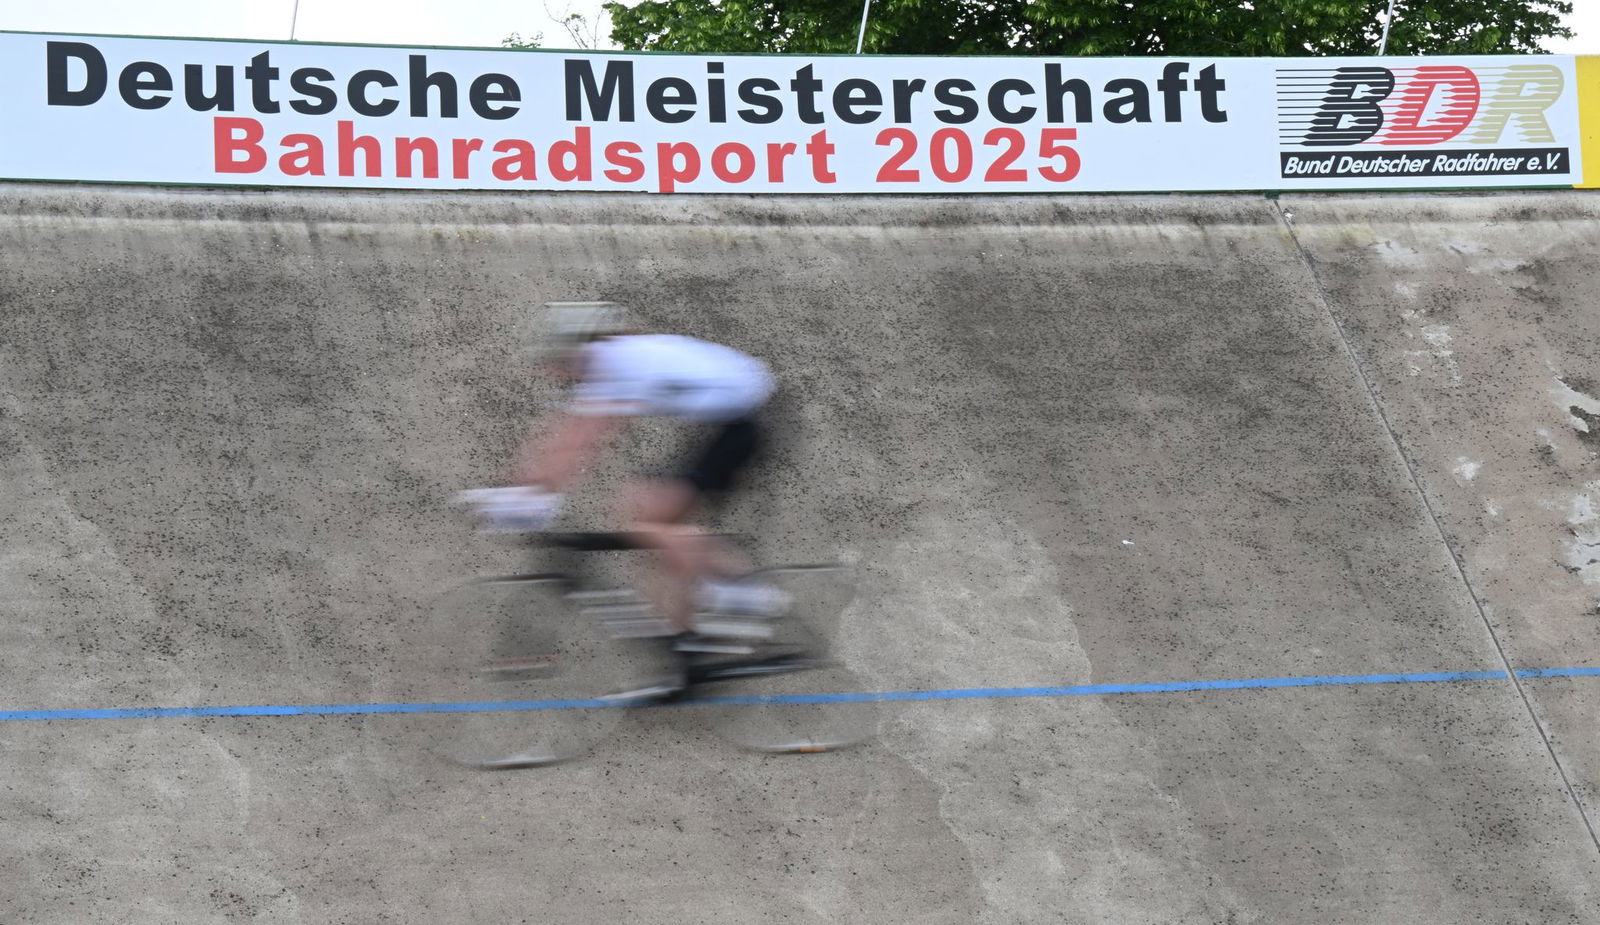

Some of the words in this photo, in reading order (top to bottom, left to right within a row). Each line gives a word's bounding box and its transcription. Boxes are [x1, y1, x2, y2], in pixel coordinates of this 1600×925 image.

[47, 41, 521, 120] Deutsche
[564, 59, 1228, 124] Meisterschaft
[1277, 64, 1564, 145] BDR
[213, 116, 835, 193] Bahnradsport
[875, 127, 1081, 183] 2025
[1284, 155, 1334, 174] Bund
[1336, 155, 1430, 173] Deutscher
[1432, 153, 1524, 172] Radfahrer
